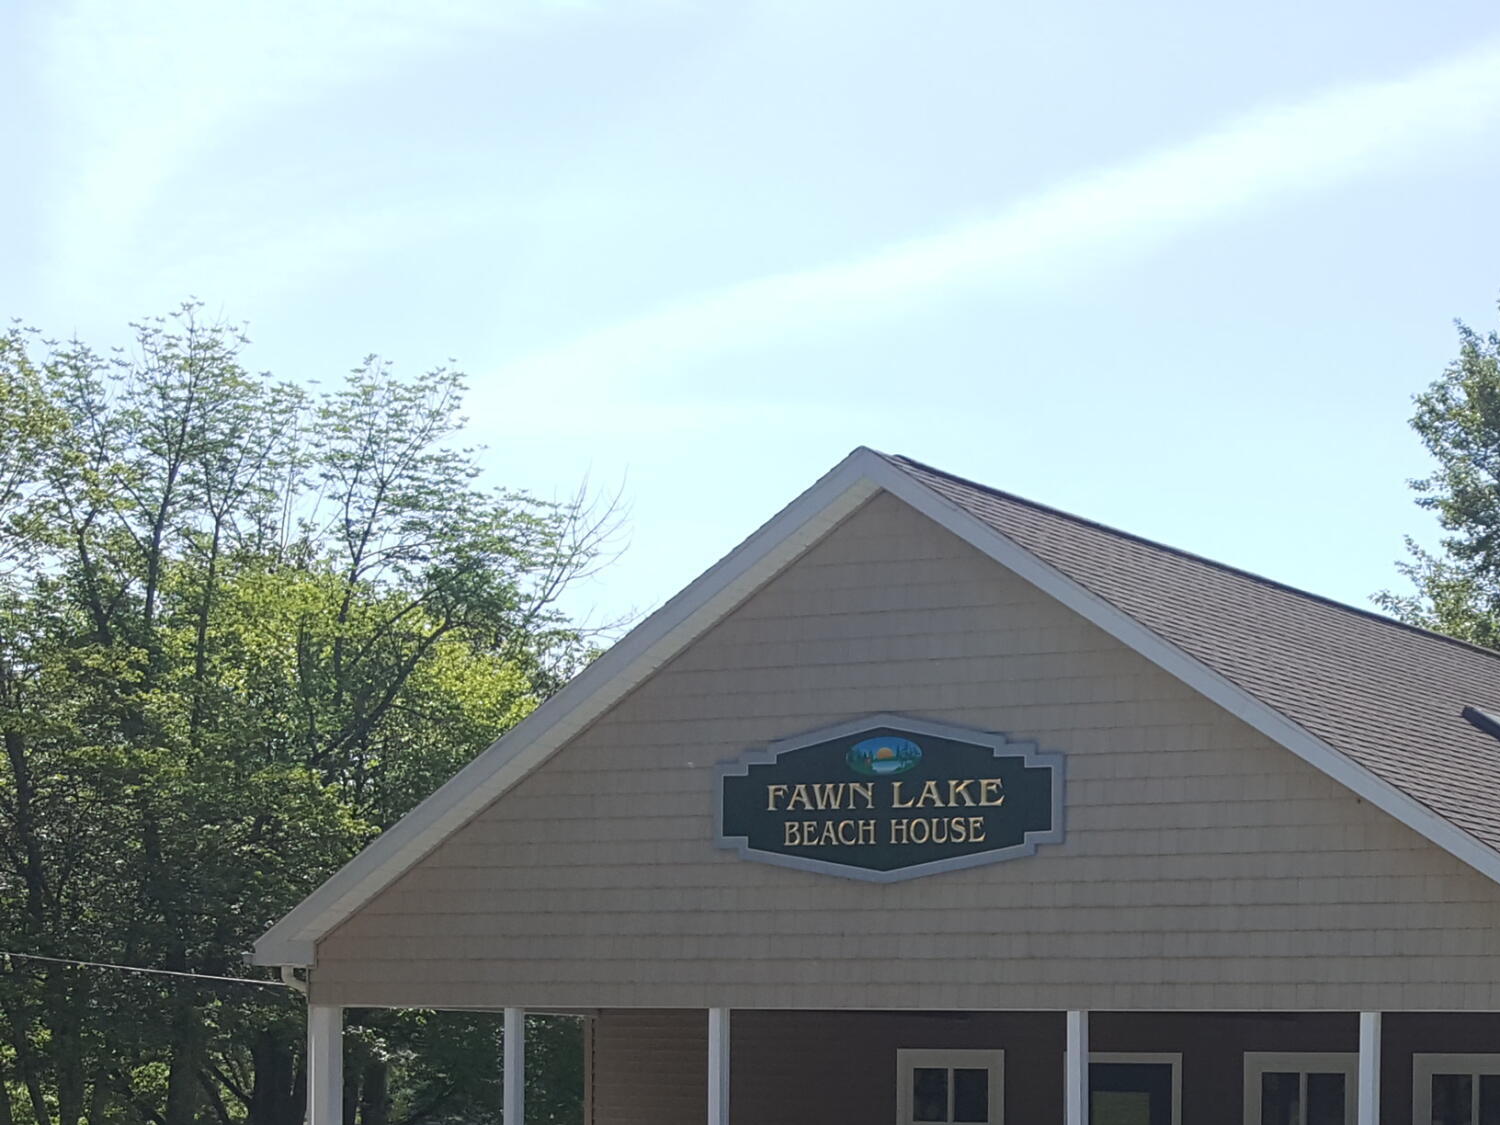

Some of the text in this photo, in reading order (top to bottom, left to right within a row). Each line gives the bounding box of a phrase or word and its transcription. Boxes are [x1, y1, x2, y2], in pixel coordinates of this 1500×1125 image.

[767, 778, 1005, 811] FAWN LAKE
[784, 816, 986, 846] BEACH HOUSE
